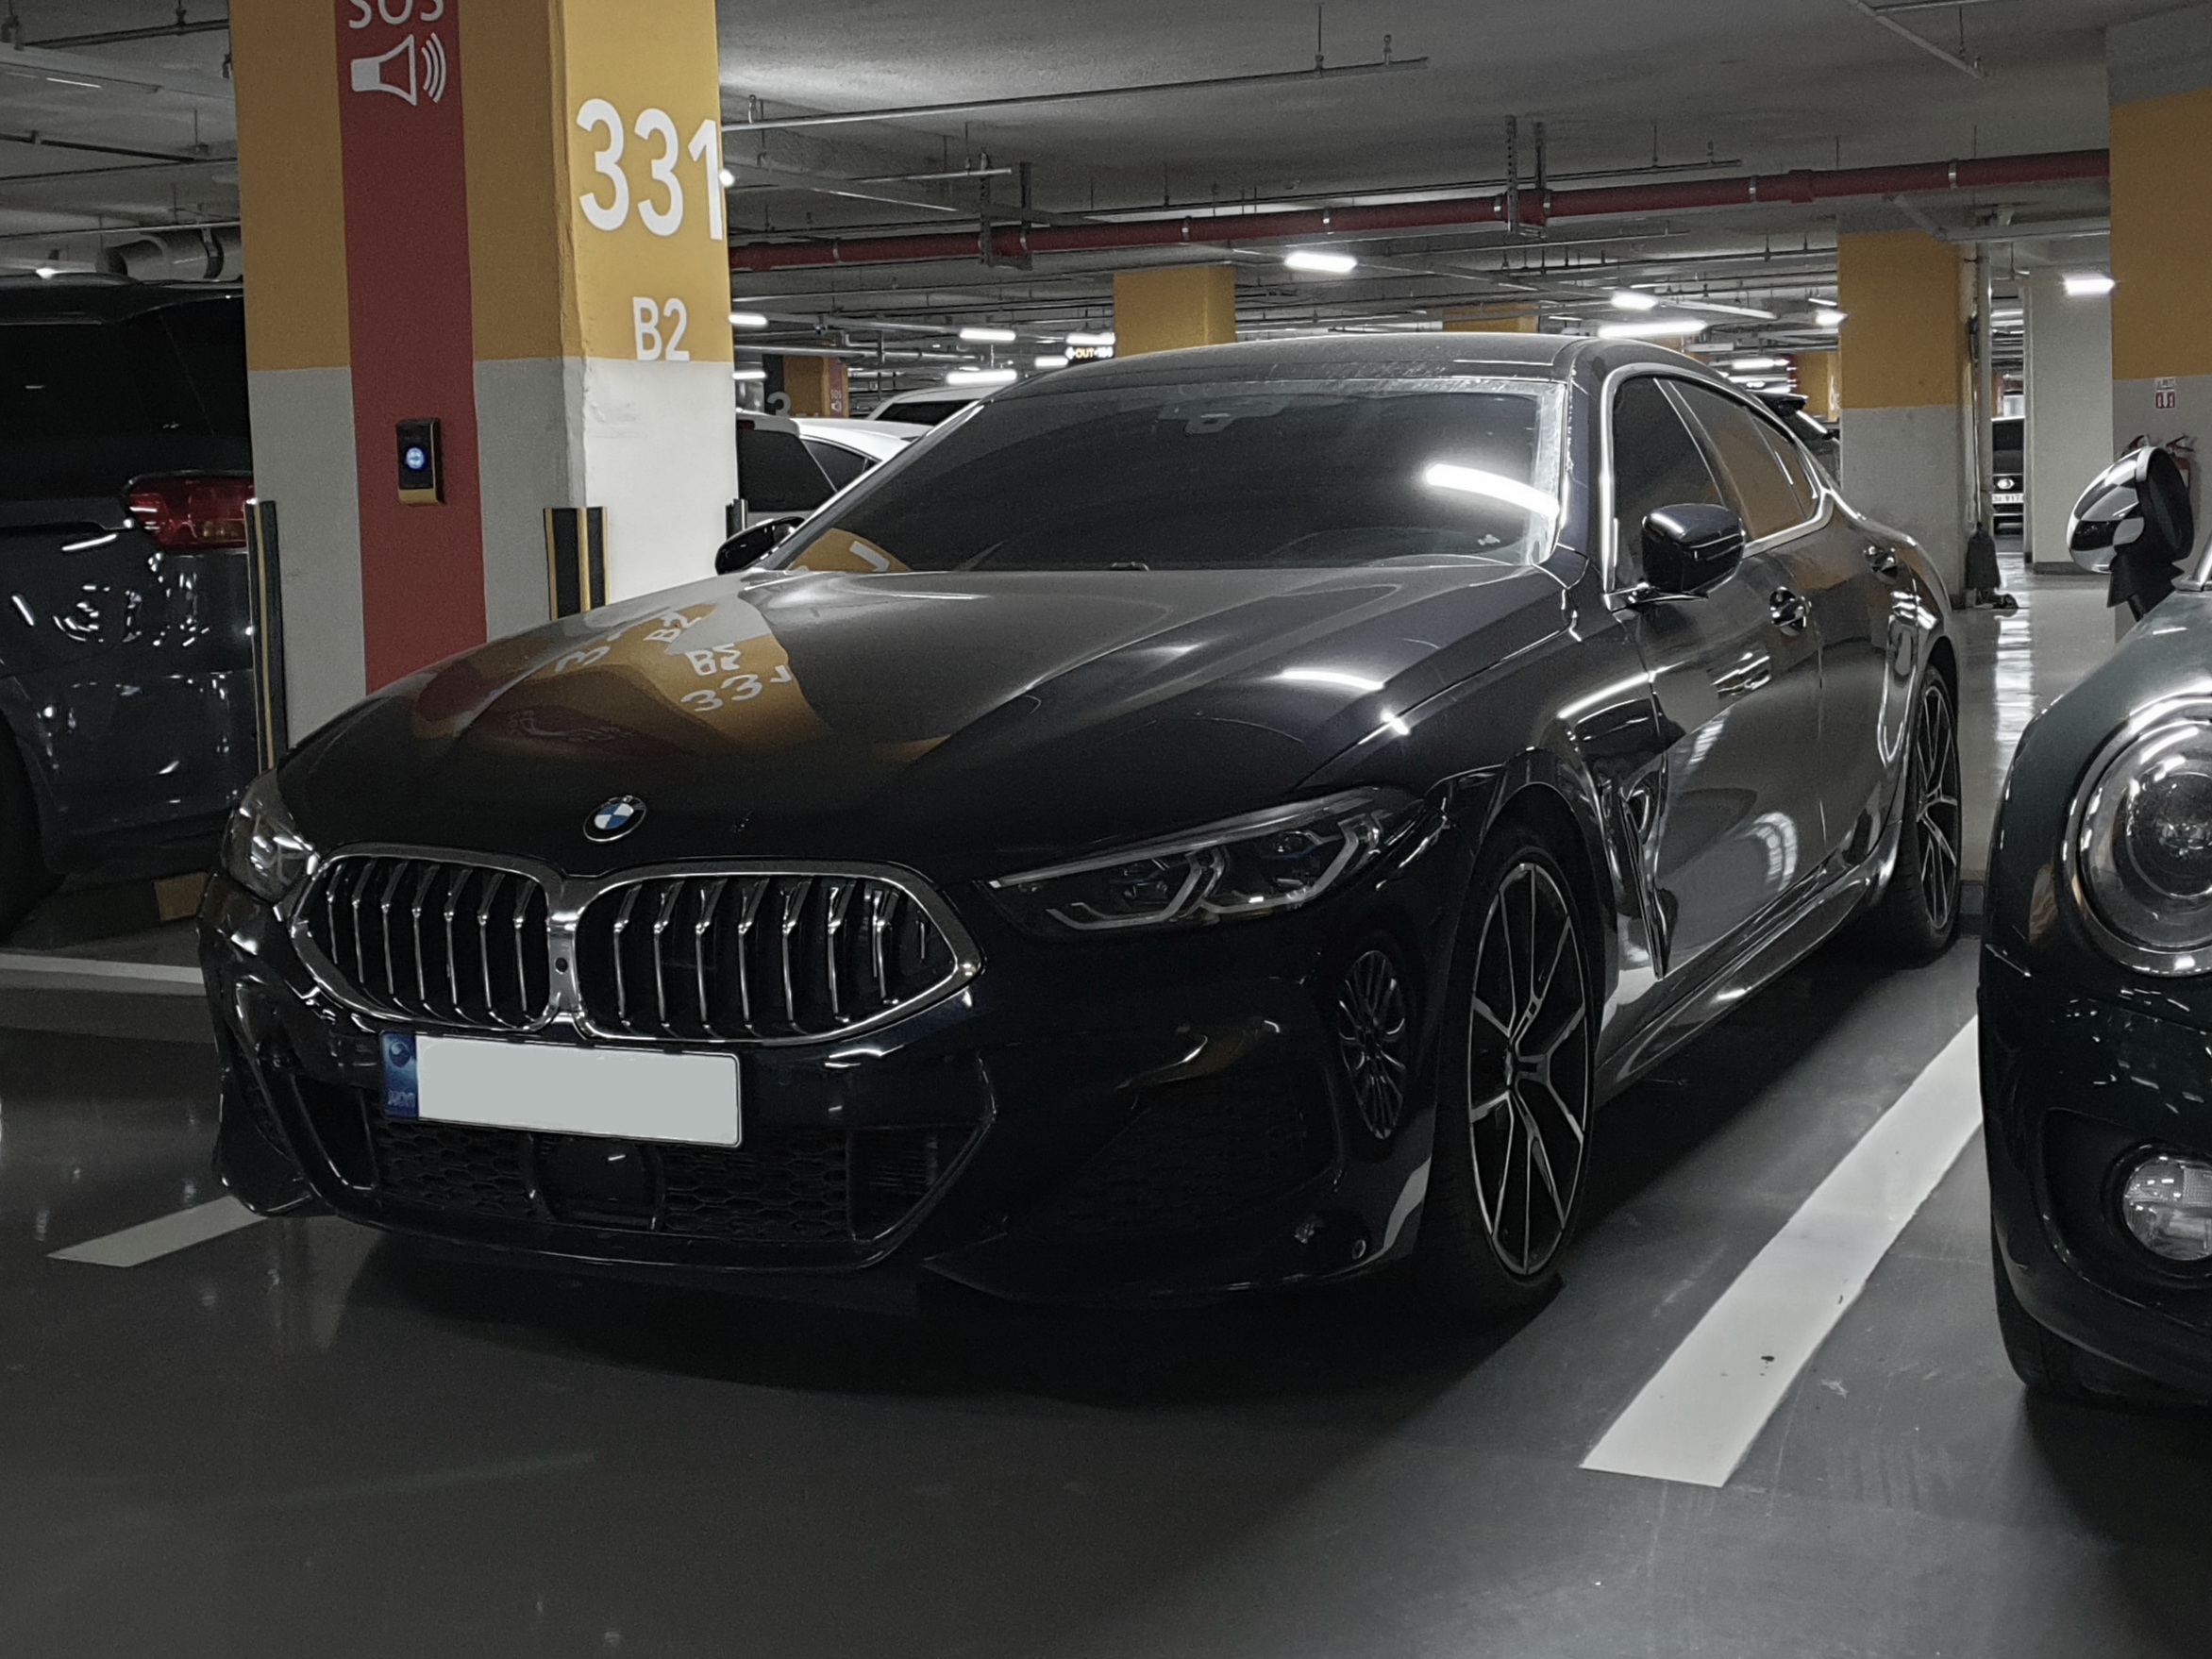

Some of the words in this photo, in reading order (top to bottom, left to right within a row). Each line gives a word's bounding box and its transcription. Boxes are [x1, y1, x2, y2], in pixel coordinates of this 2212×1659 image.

[576, 98, 724, 241] 331
[632, 296, 691, 362] B2
[1075, 346, 1096, 359] OUT
